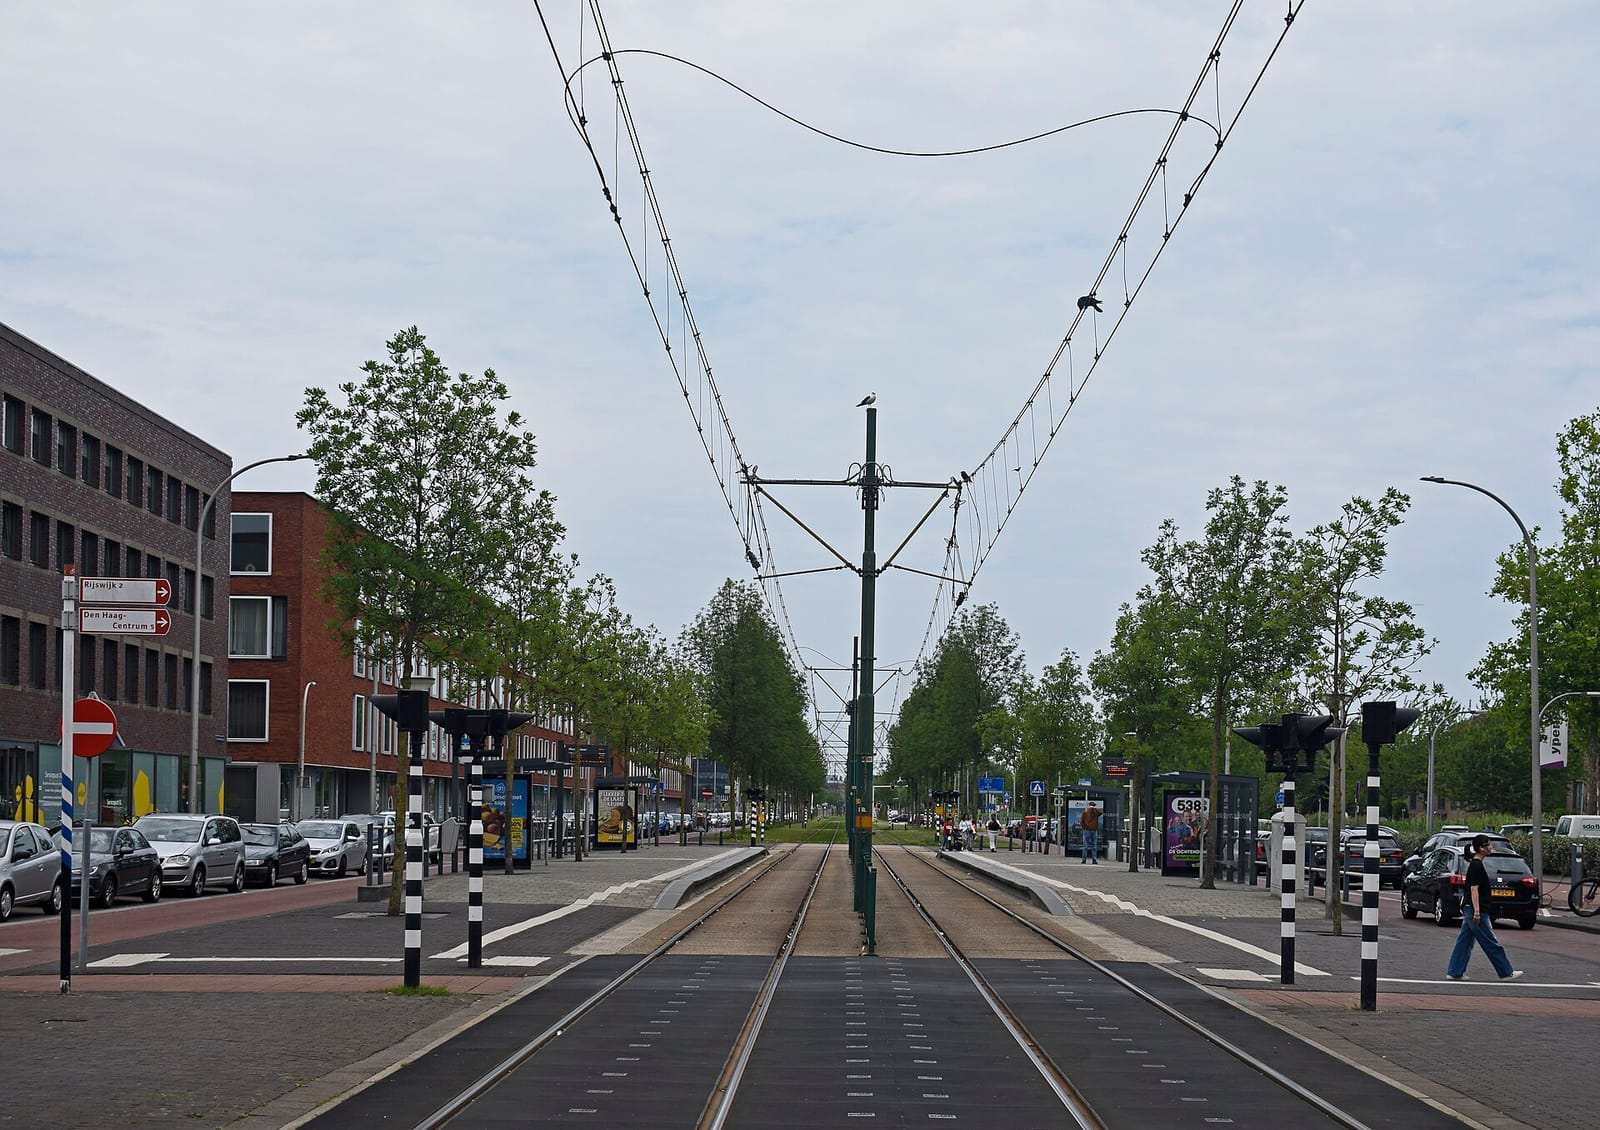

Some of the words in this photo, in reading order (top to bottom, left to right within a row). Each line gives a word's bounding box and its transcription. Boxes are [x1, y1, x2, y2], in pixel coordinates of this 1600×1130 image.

[84, 581, 117, 589] Rijswijk
[102, 612, 127, 620] Haag-
[112, 622, 148, 630] Centrum
[1177, 800, 1202, 811] 538
